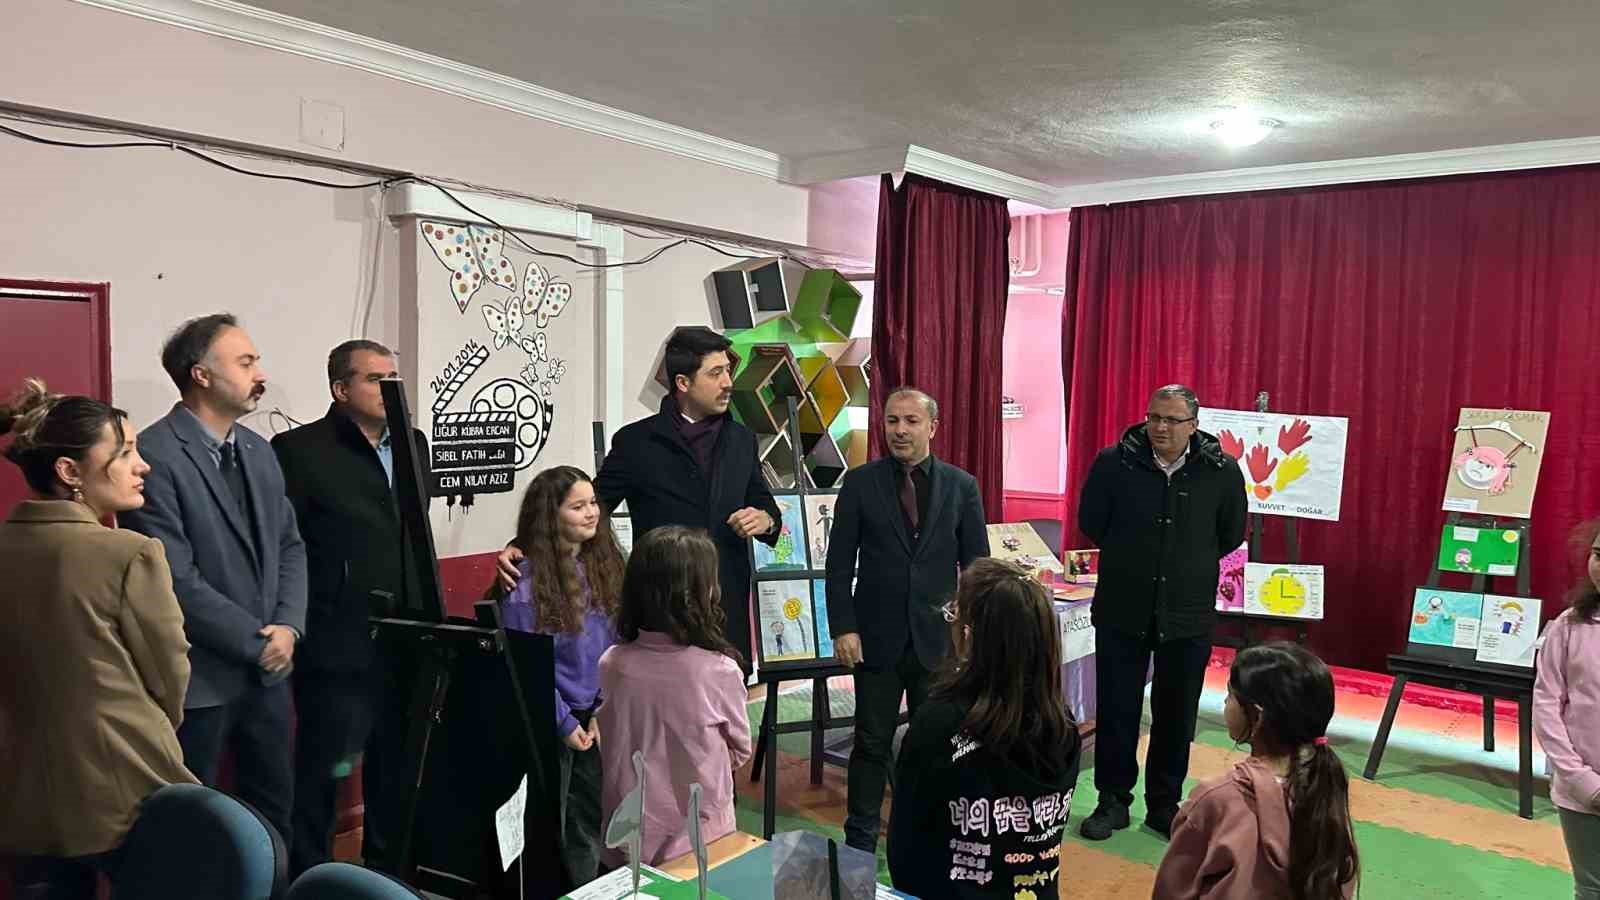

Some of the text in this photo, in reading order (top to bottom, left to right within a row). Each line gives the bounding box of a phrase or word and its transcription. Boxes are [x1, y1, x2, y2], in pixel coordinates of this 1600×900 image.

[430, 338, 478, 393] 24.01.2014
[486, 425, 510, 436] ERCAN
[949, 797, 990, 837] 너의
[993, 796, 1032, 834] 꿈을
[1004, 852, 1035, 864] GOOD
